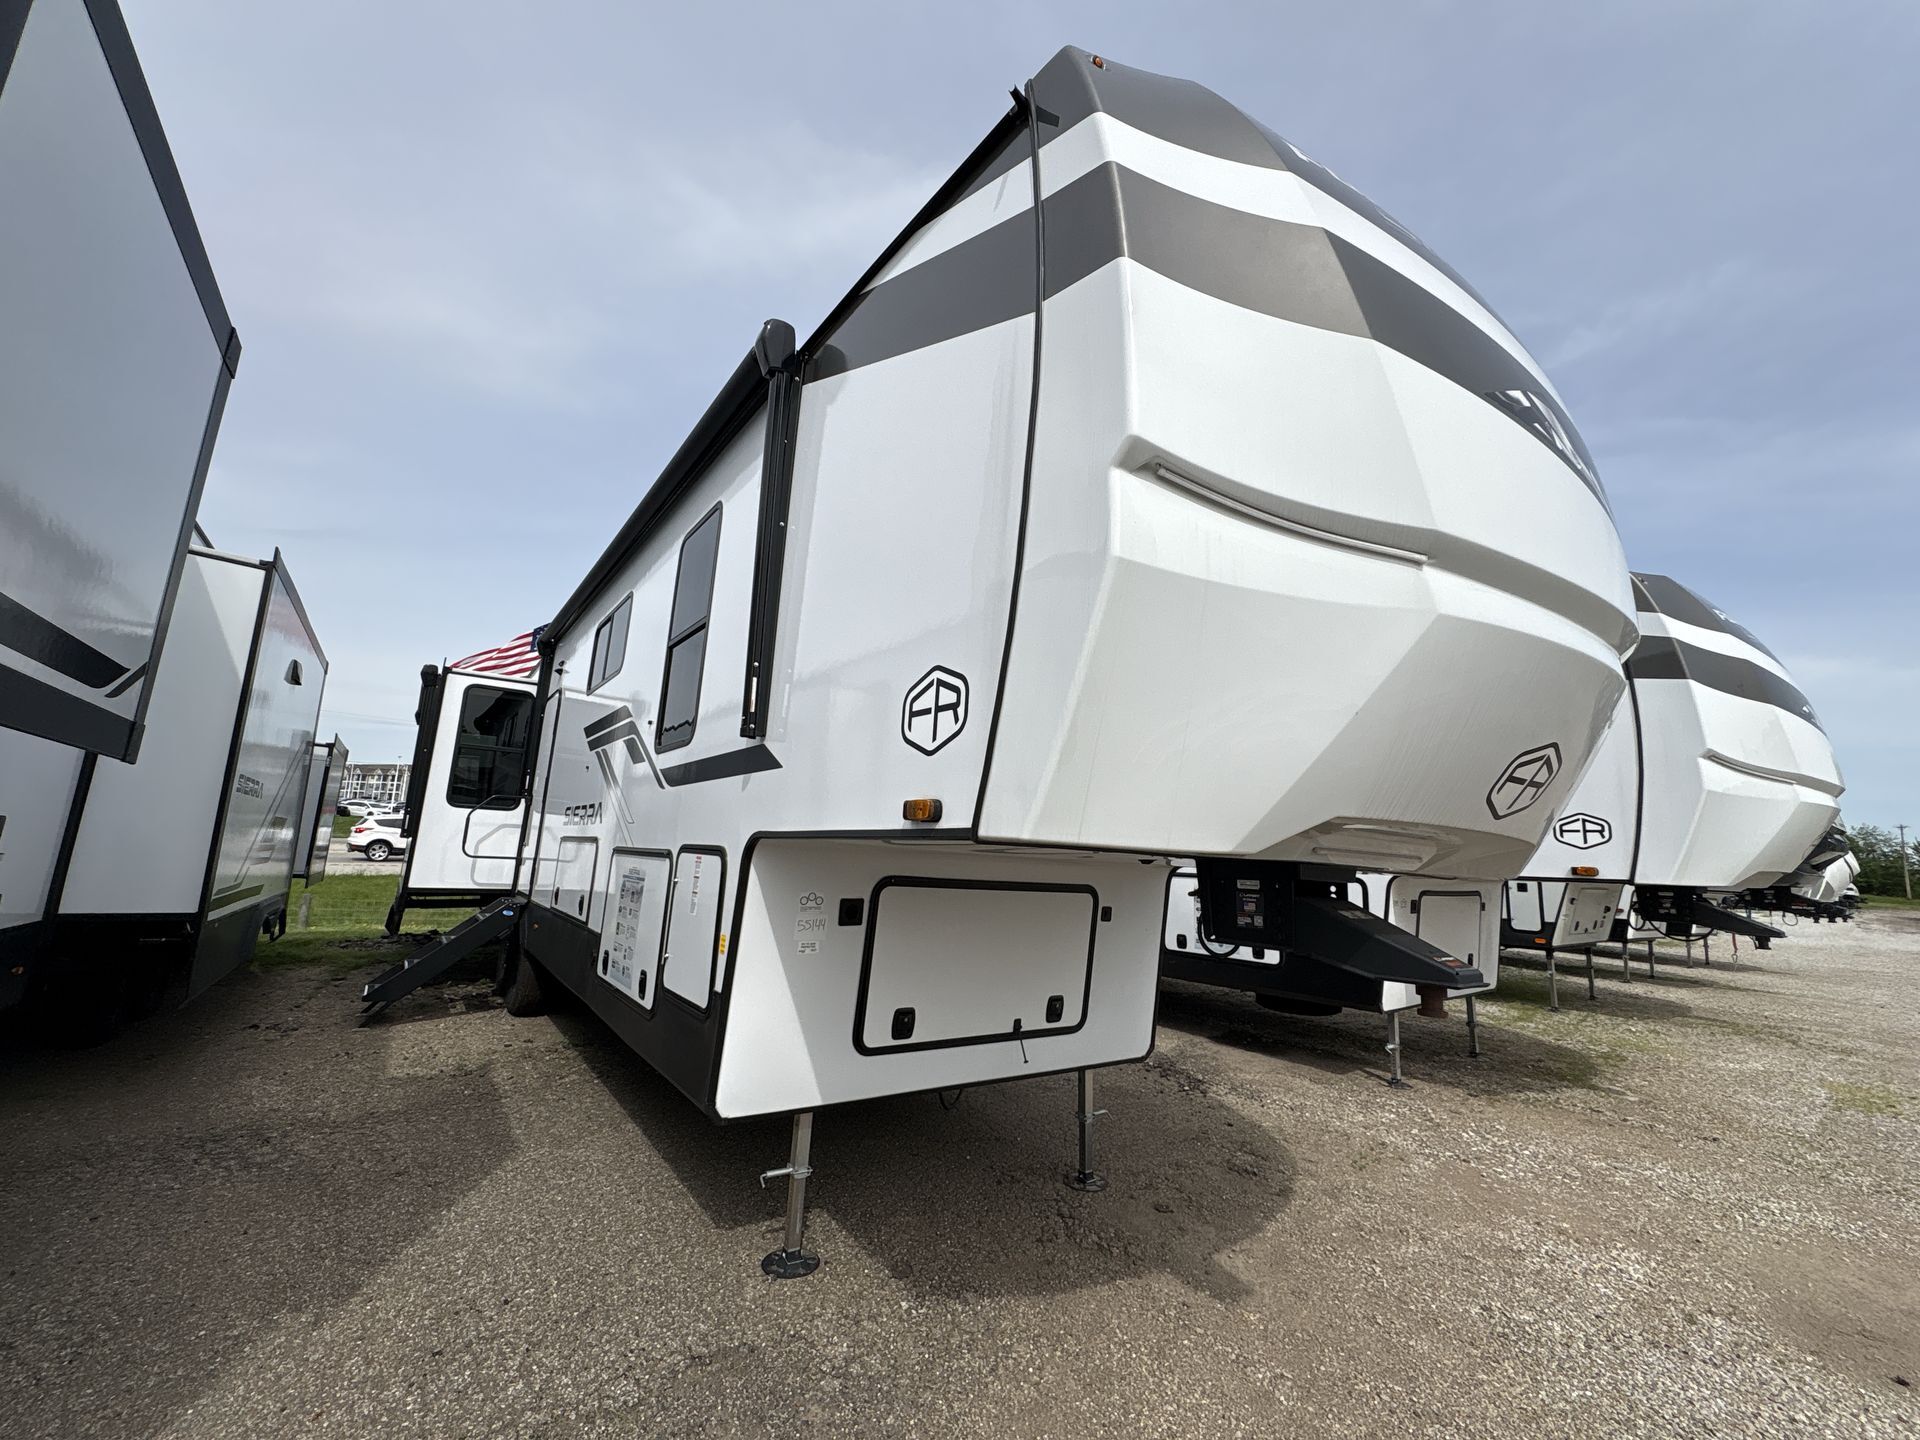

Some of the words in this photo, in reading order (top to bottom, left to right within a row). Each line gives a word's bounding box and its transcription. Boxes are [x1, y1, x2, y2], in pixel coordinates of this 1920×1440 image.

[906, 676, 962, 745] FR
[563, 801, 603, 826] SIERRA
[1558, 816, 1607, 846] FR
